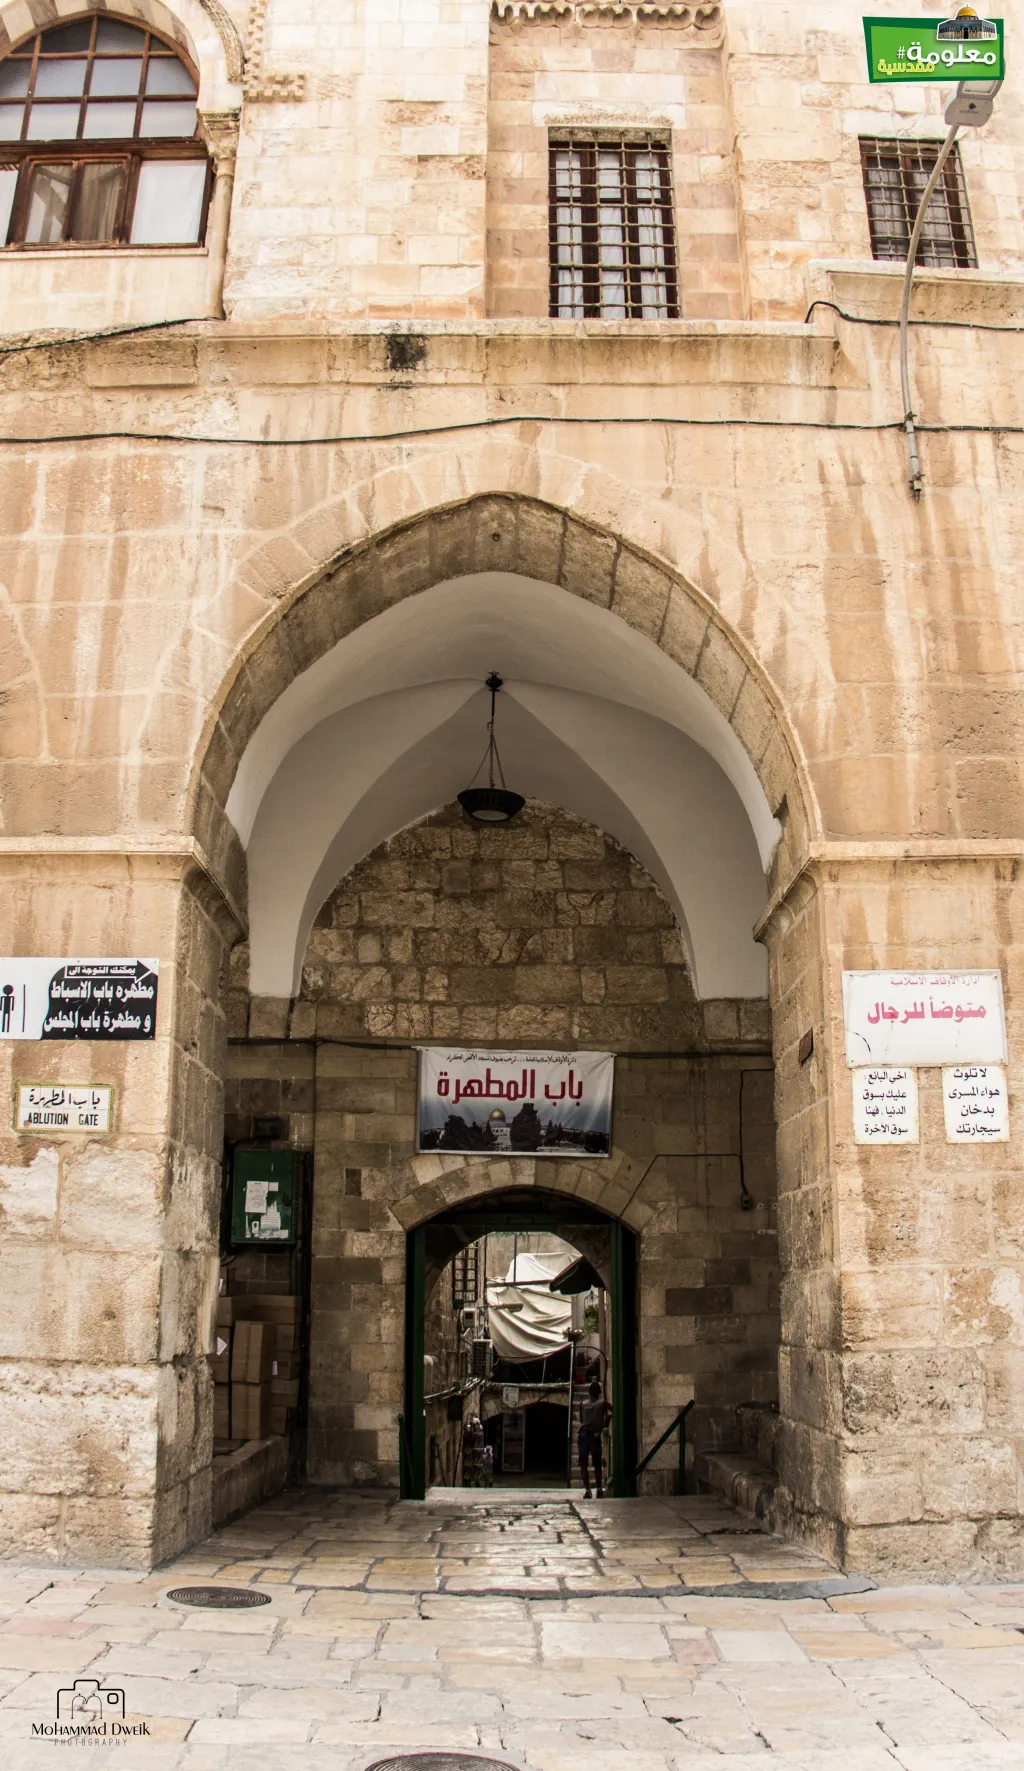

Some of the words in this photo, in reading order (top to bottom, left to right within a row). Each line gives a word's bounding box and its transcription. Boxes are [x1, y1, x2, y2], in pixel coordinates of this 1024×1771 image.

[110, 965, 136, 976] يمكنك
[51, 980, 91, 1001] الاسباط
[94, 980, 114, 1002] باب
[867, 1001, 926, 1024] للرجال
[930, 995, 987, 1023] متوضأ
[44, 1010, 79, 1032] المجلس
[80, 1010, 101, 1032] باب
[103, 1010, 141, 1032] مطهرة
[143, 1014, 151, 1032] و
[954, 1067, 978, 1081] تلوث
[979, 1068, 987, 1077] لا
[437, 1068, 536, 1105] المطهرة
[544, 1070, 583, 1107] باب
[948, 1086, 979, 1099] المسرى
[980, 1086, 1000, 1099] هواء
[29, 1088, 71, 1107] المطهرة
[73, 1091, 100, 1109] باب
[863, 1089, 885, 1101] بسوق
[886, 1089, 907, 1101] عليك
[27, 1112, 69, 1125] ABLUTION
[78, 1114, 99, 1126] GATE
[865, 1105, 880, 1117] فهنا
[886, 1105, 907, 1118] الدنيا
[890, 1123, 909, 1136] سوق
[956, 1123, 1001, 1136] سيجارتك
